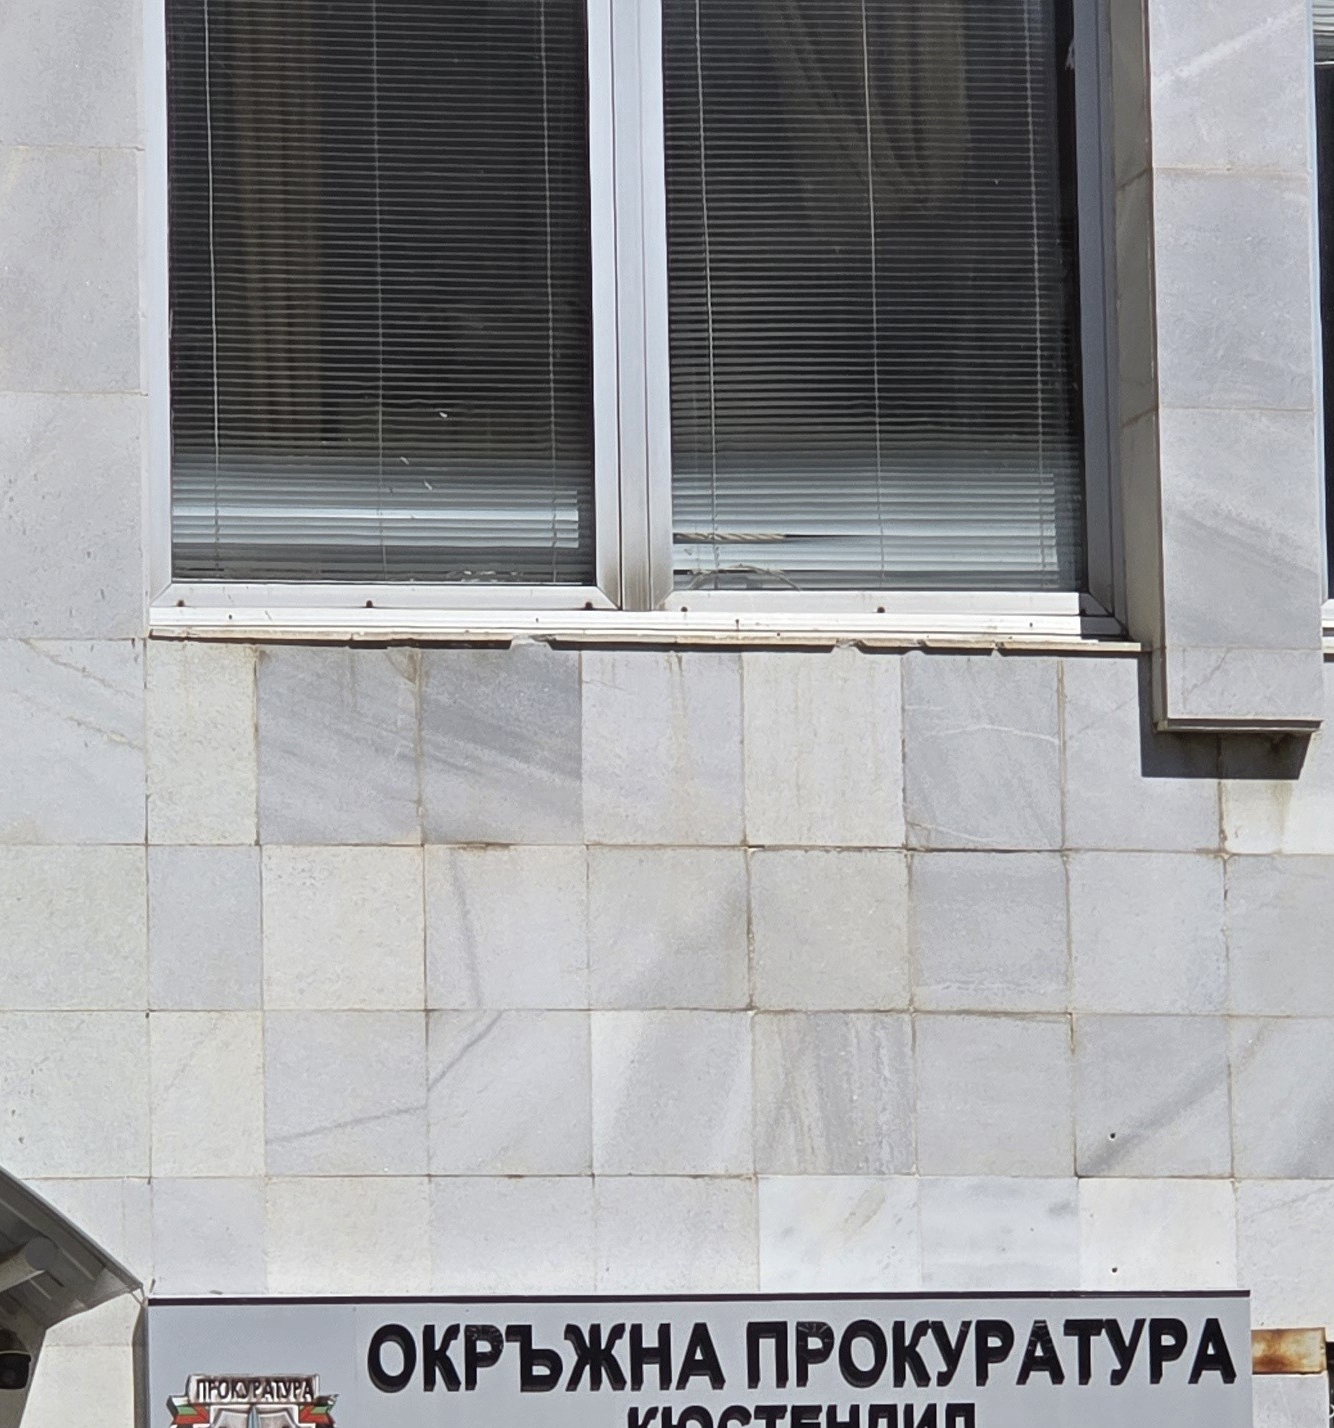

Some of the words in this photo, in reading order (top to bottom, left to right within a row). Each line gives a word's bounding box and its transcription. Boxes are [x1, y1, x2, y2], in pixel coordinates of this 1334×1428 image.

[366, 1320, 728, 1394] ОКРЪЖНА
[745, 1317, 1238, 1390] ПРОКУРАТУРА
[196, 1378, 315, 1400] ПРОКУРАТУРА
